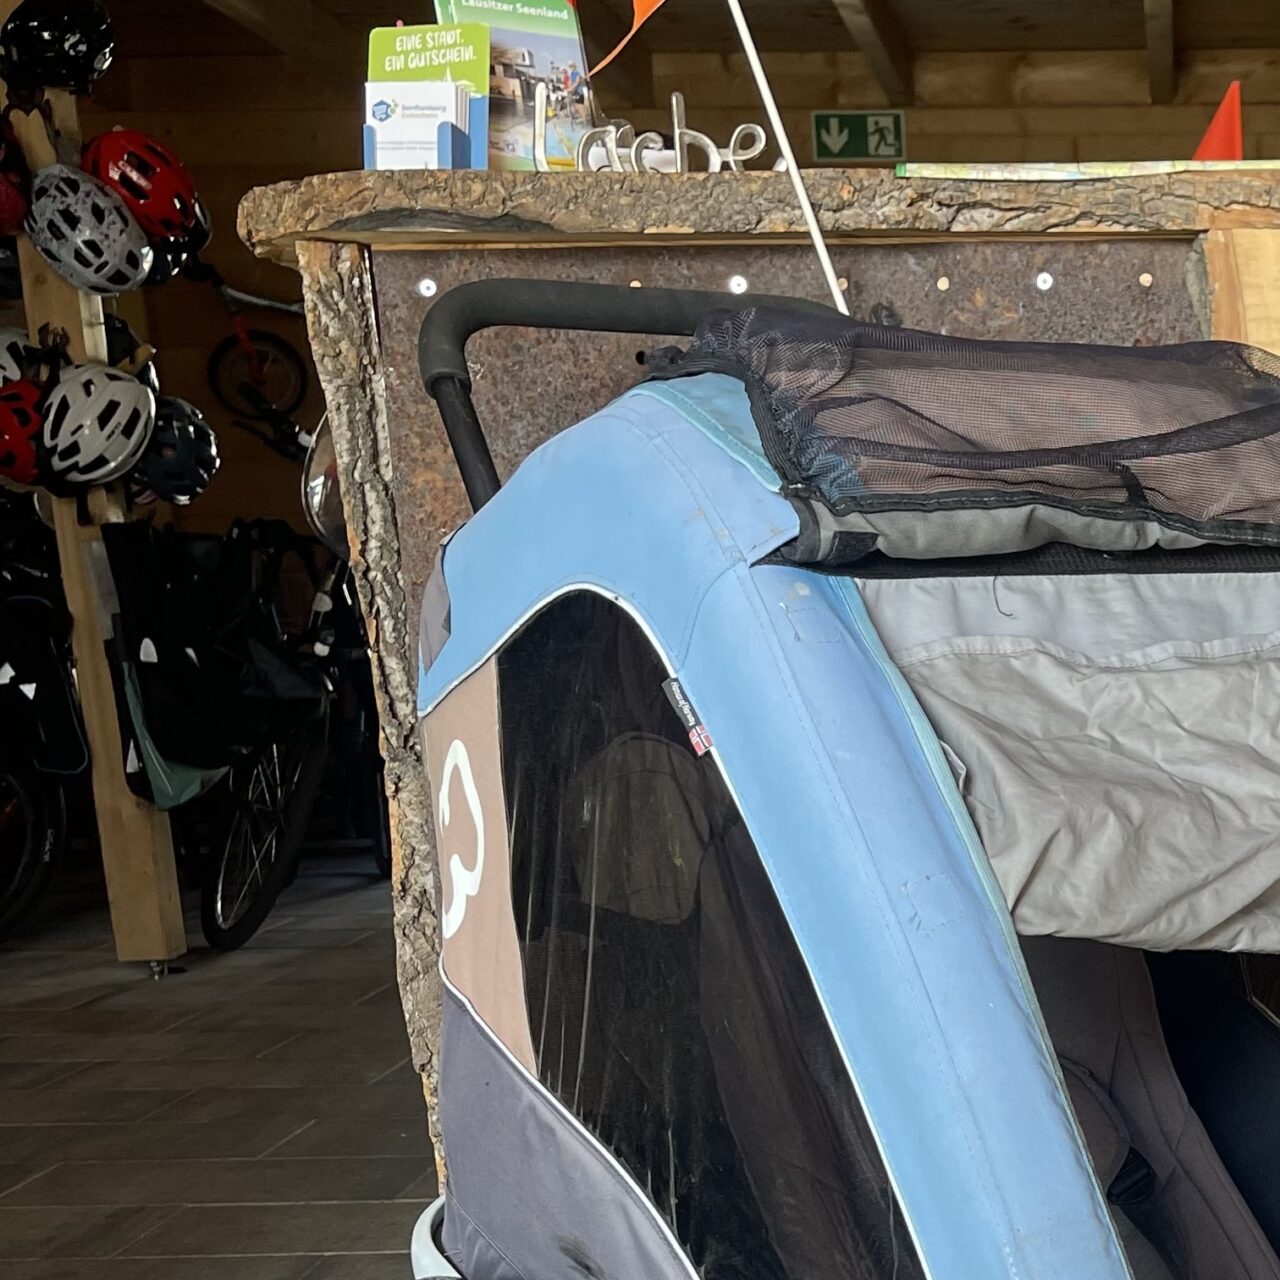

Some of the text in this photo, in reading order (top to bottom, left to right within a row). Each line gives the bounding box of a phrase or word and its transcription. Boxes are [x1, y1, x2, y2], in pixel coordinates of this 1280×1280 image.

[515, 3, 569, 20] Seenland
[395, 29, 465, 52] EINE STADT.
[384, 45, 477, 72] EIN GUTSCHEIN.
